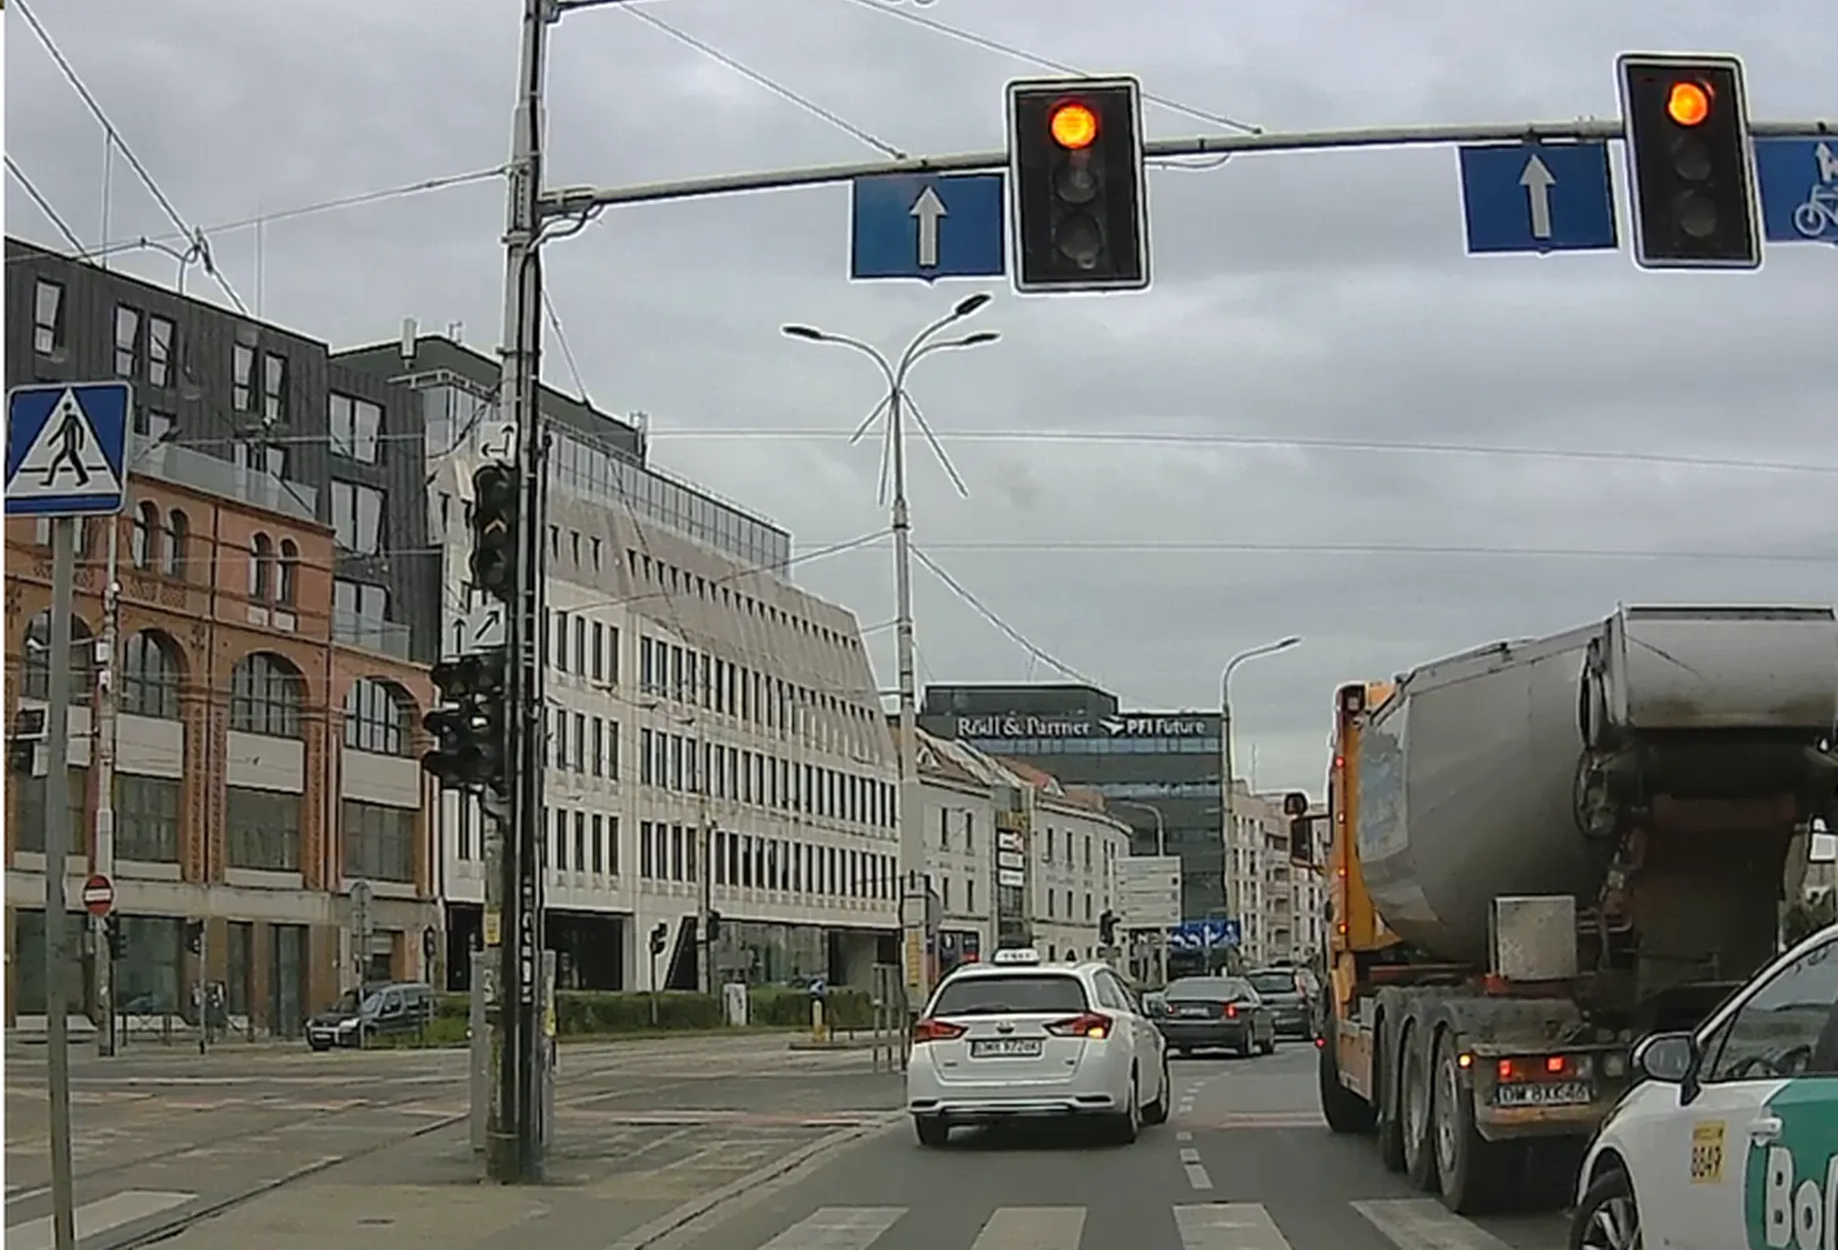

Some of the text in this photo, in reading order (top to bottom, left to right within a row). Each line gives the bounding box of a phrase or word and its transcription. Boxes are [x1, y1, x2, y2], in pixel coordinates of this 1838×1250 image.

[957, 716, 1092, 736] Rödl & Partner
[1127, 718, 1205, 735] PFI Future
